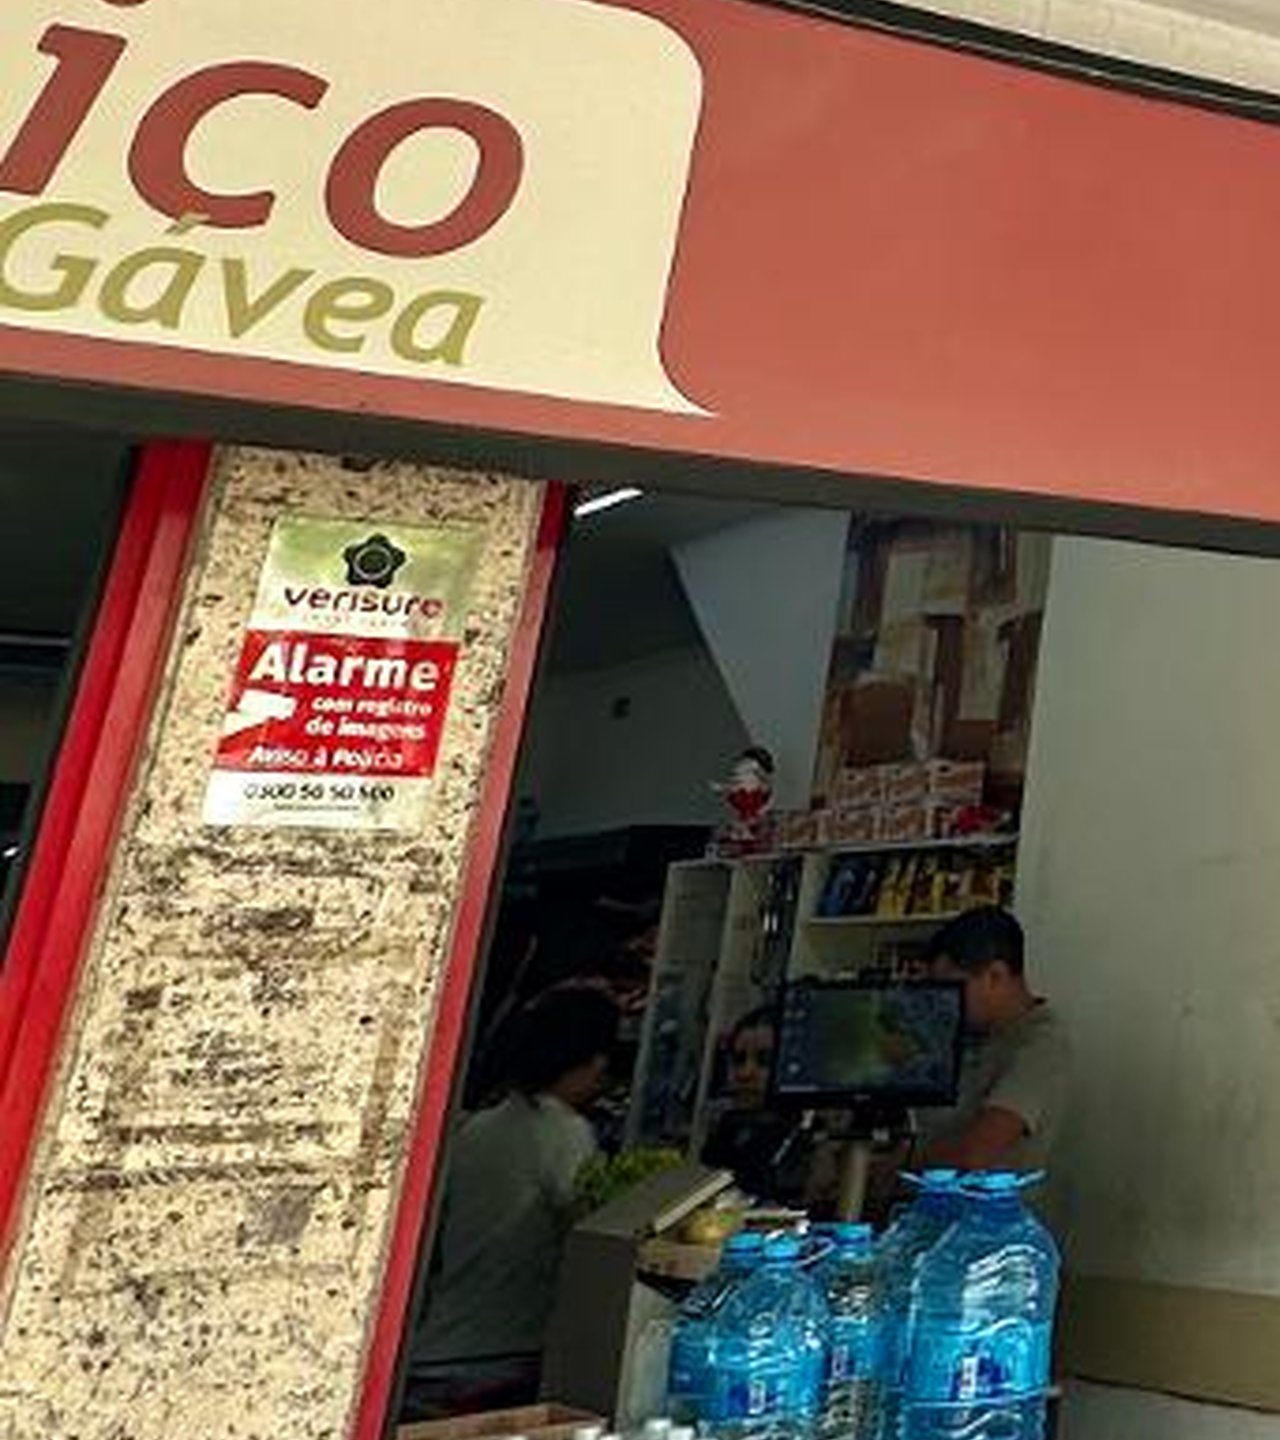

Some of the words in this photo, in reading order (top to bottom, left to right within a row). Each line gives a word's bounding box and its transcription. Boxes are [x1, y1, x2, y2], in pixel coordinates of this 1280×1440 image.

[0, 200, 487, 367] Gávea
[284, 585, 444, 619] verisure
[248, 641, 441, 692] Alarme
[311, 696, 353, 713] com
[356, 697, 433, 718] registro
[305, 716, 335, 737] de
